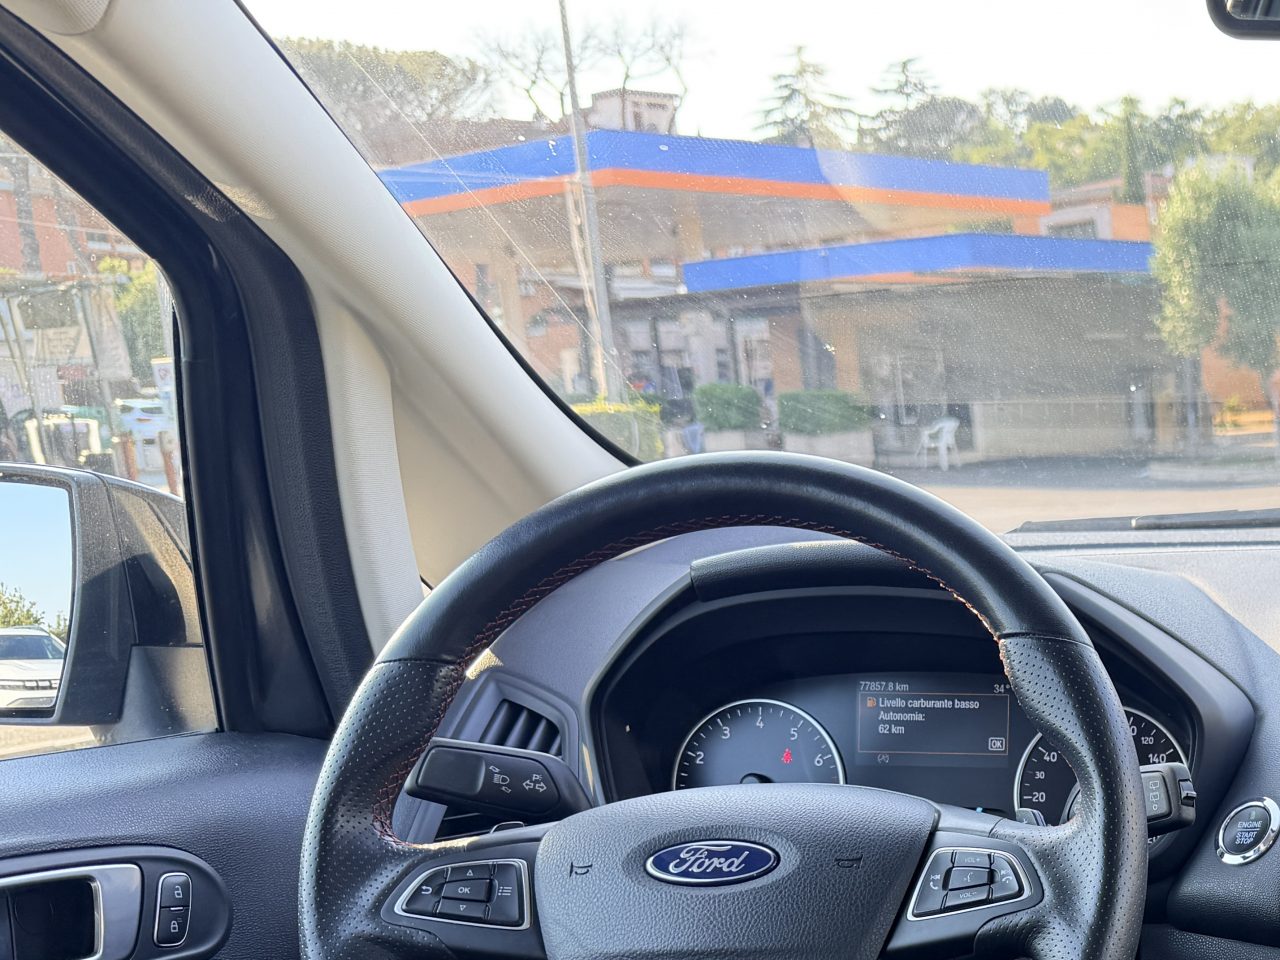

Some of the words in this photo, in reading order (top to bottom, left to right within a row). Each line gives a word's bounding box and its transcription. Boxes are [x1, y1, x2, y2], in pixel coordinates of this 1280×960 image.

[859, 681, 894, 691] 77857.8
[896, 682, 909, 692] km
[879, 698, 906, 708] Livello
[907, 698, 953, 709] carburante
[954, 699, 980, 709] basso
[878, 711, 926, 721] Autonomia:
[756, 716, 764, 729] 4
[721, 726, 731, 739] 3
[790, 728, 798, 740] 5
[878, 724, 890, 734] 62
[891, 724, 905, 734] km
[991, 740, 1003, 748] OK
[1141, 736, 1154, 745] 120
[695, 751, 705, 765] 2
[814, 755, 824, 767] 6
[1043, 751, 1058, 762] 40
[1148, 753, 1167, 764] 140
[1034, 771, 1045, 779] 30
[1032, 791, 1046, 802] 20
[1237, 820, 1263, 829] ENGINE
[1235, 831, 1258, 839] START
[1234, 837, 1254, 845] STOP
[668, 845, 750, 874] Ford
[458, 886, 471, 894] OK
